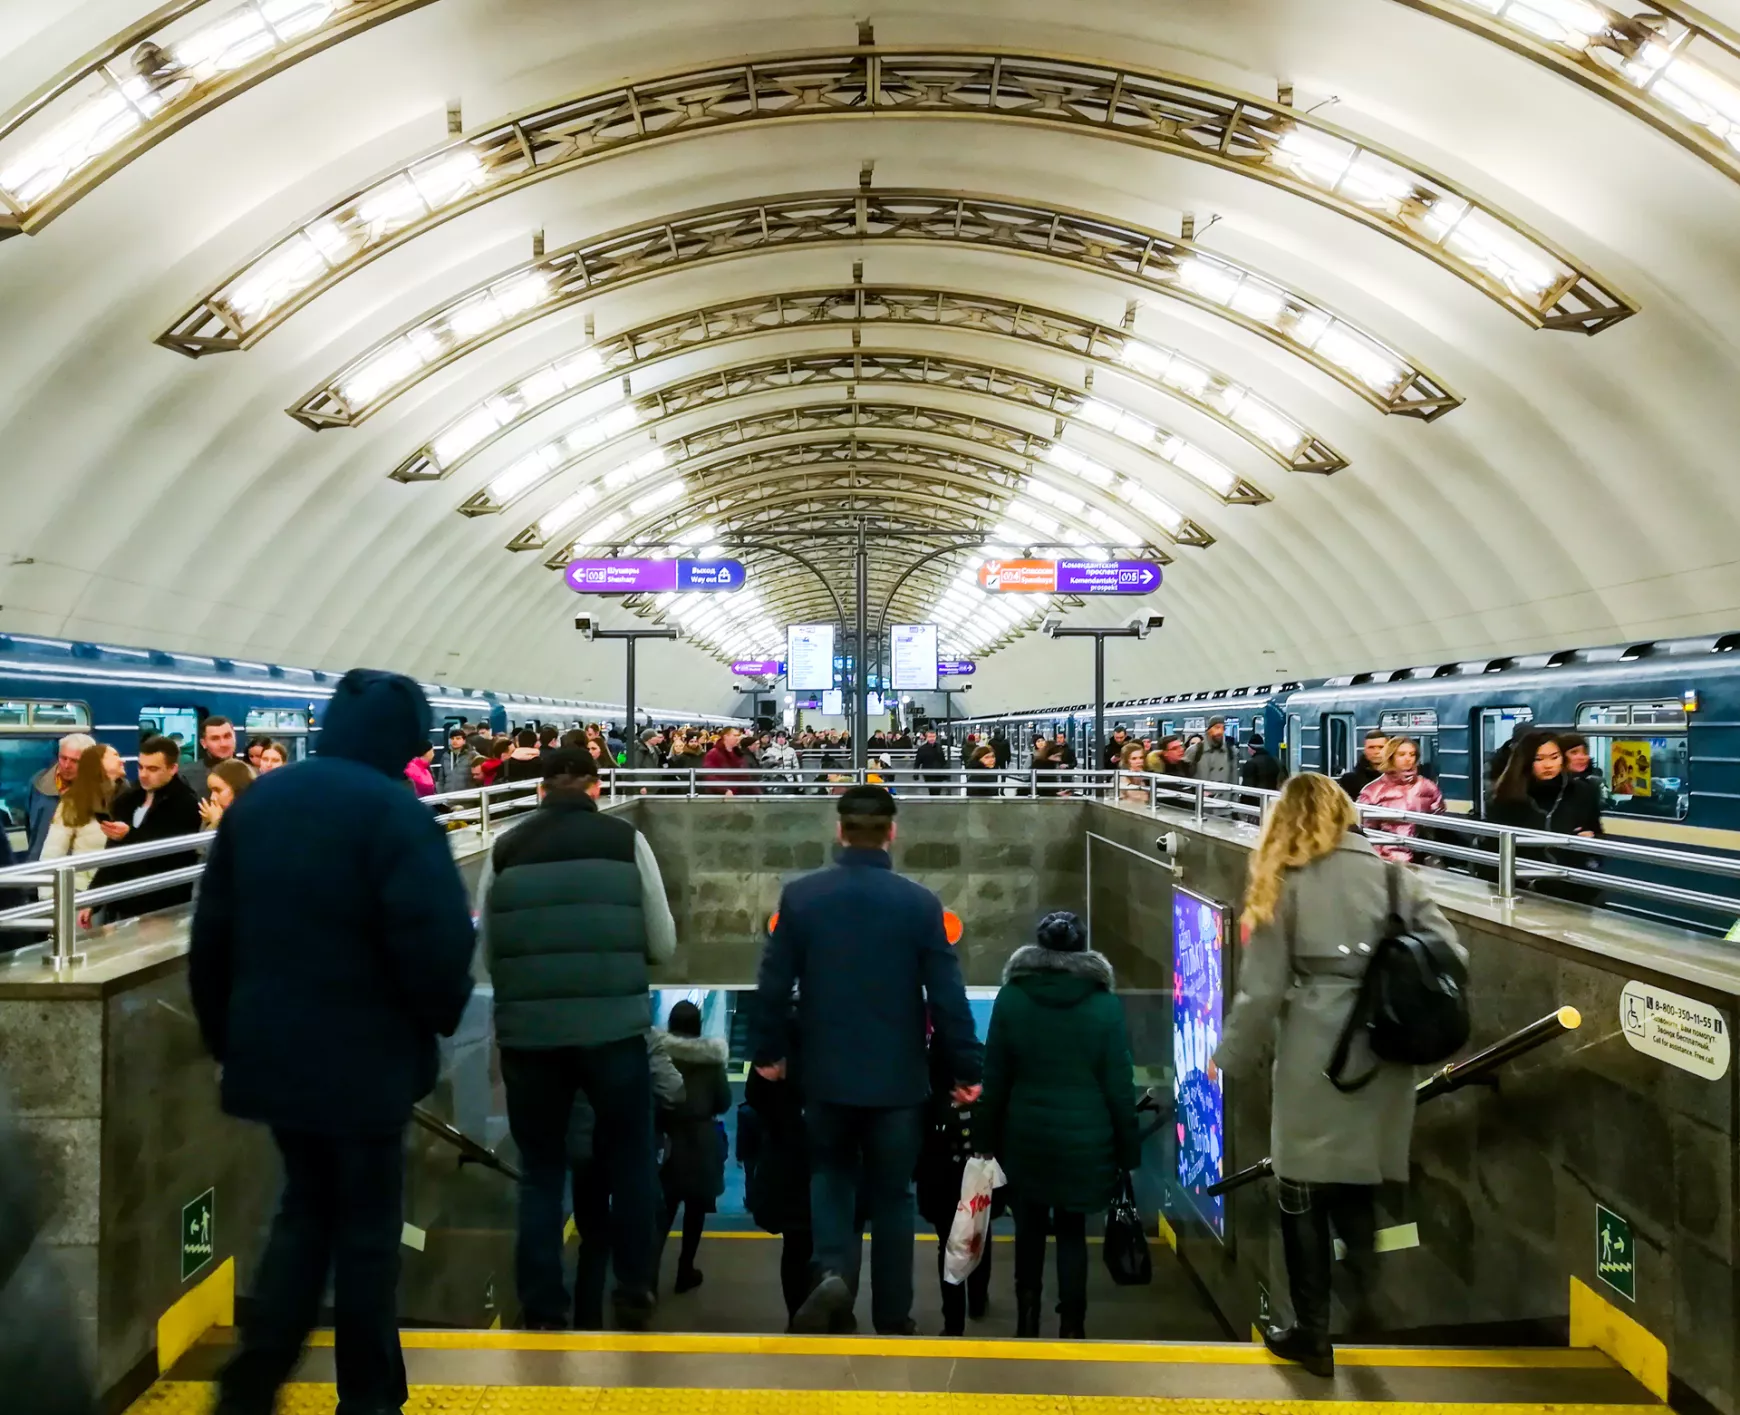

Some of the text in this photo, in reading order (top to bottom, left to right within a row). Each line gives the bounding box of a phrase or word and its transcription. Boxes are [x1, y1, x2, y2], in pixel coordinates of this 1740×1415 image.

[692, 567, 716, 575] Выход
[691, 576, 705, 584] Way
[1655, 1000, 1712, 1028] 8-800-350-11-55
